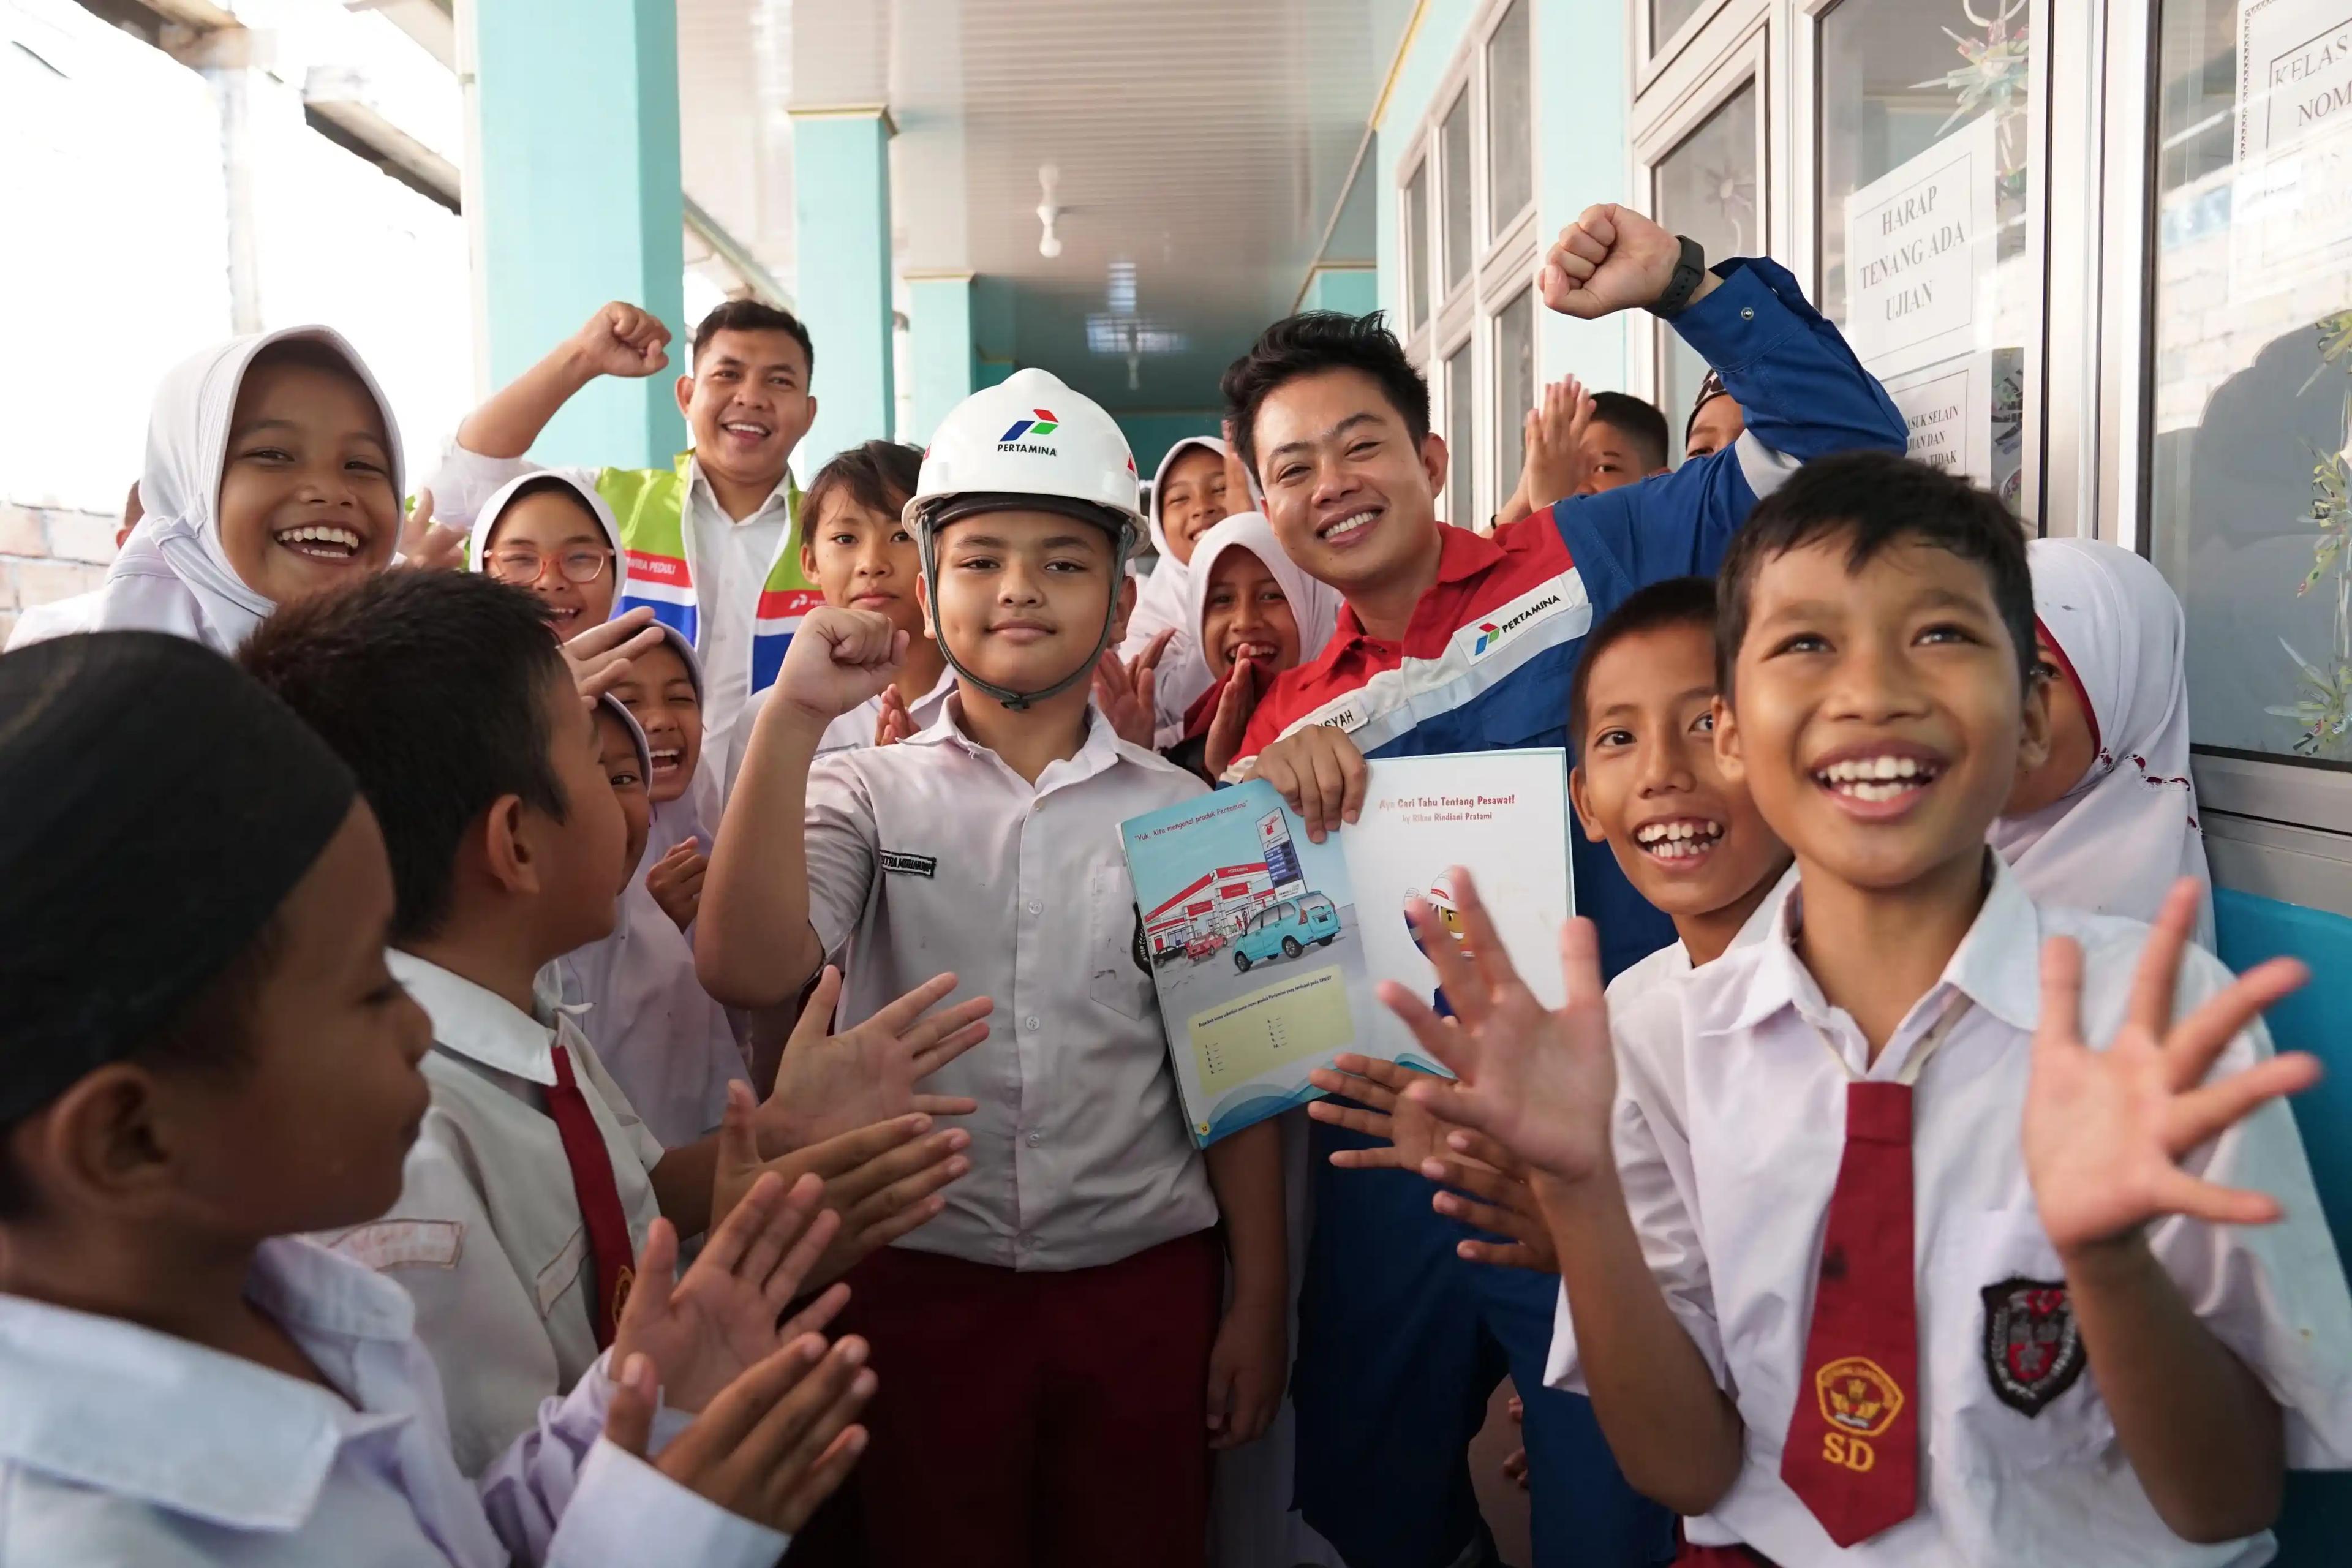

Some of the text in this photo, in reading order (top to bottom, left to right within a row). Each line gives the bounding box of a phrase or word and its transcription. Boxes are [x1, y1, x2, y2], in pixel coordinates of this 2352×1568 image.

[2275, 34, 2348, 85] KELAS
[1882, 186, 1937, 236] HARAP
[1860, 219, 1965, 290] TENANG ADA
[1887, 279, 1932, 321] UJIAN
[1929, 404, 1959, 424] SELAIN
[1928, 431, 1945, 447] DAN
[997, 443, 1058, 457] PERTAMINA
[1929, 450, 1957, 466] TIDAK
[650, 561, 676, 575] PEDULI
[1502, 595, 1561, 633] PERTAMINA
[1321, 710, 1354, 727] SYAH
[1398, 798, 1415, 808] Cari
[1418, 797, 1438, 807] Tahu
[1441, 797, 1474, 808] Tentang
[1477, 794, 1515, 805] Pesawat!
[1167, 818, 1194, 832] mengenal
[1196, 810, 1216, 823] produk
[1465, 812, 1493, 820] Pratami
[1822, 1431, 1875, 1472] SD
